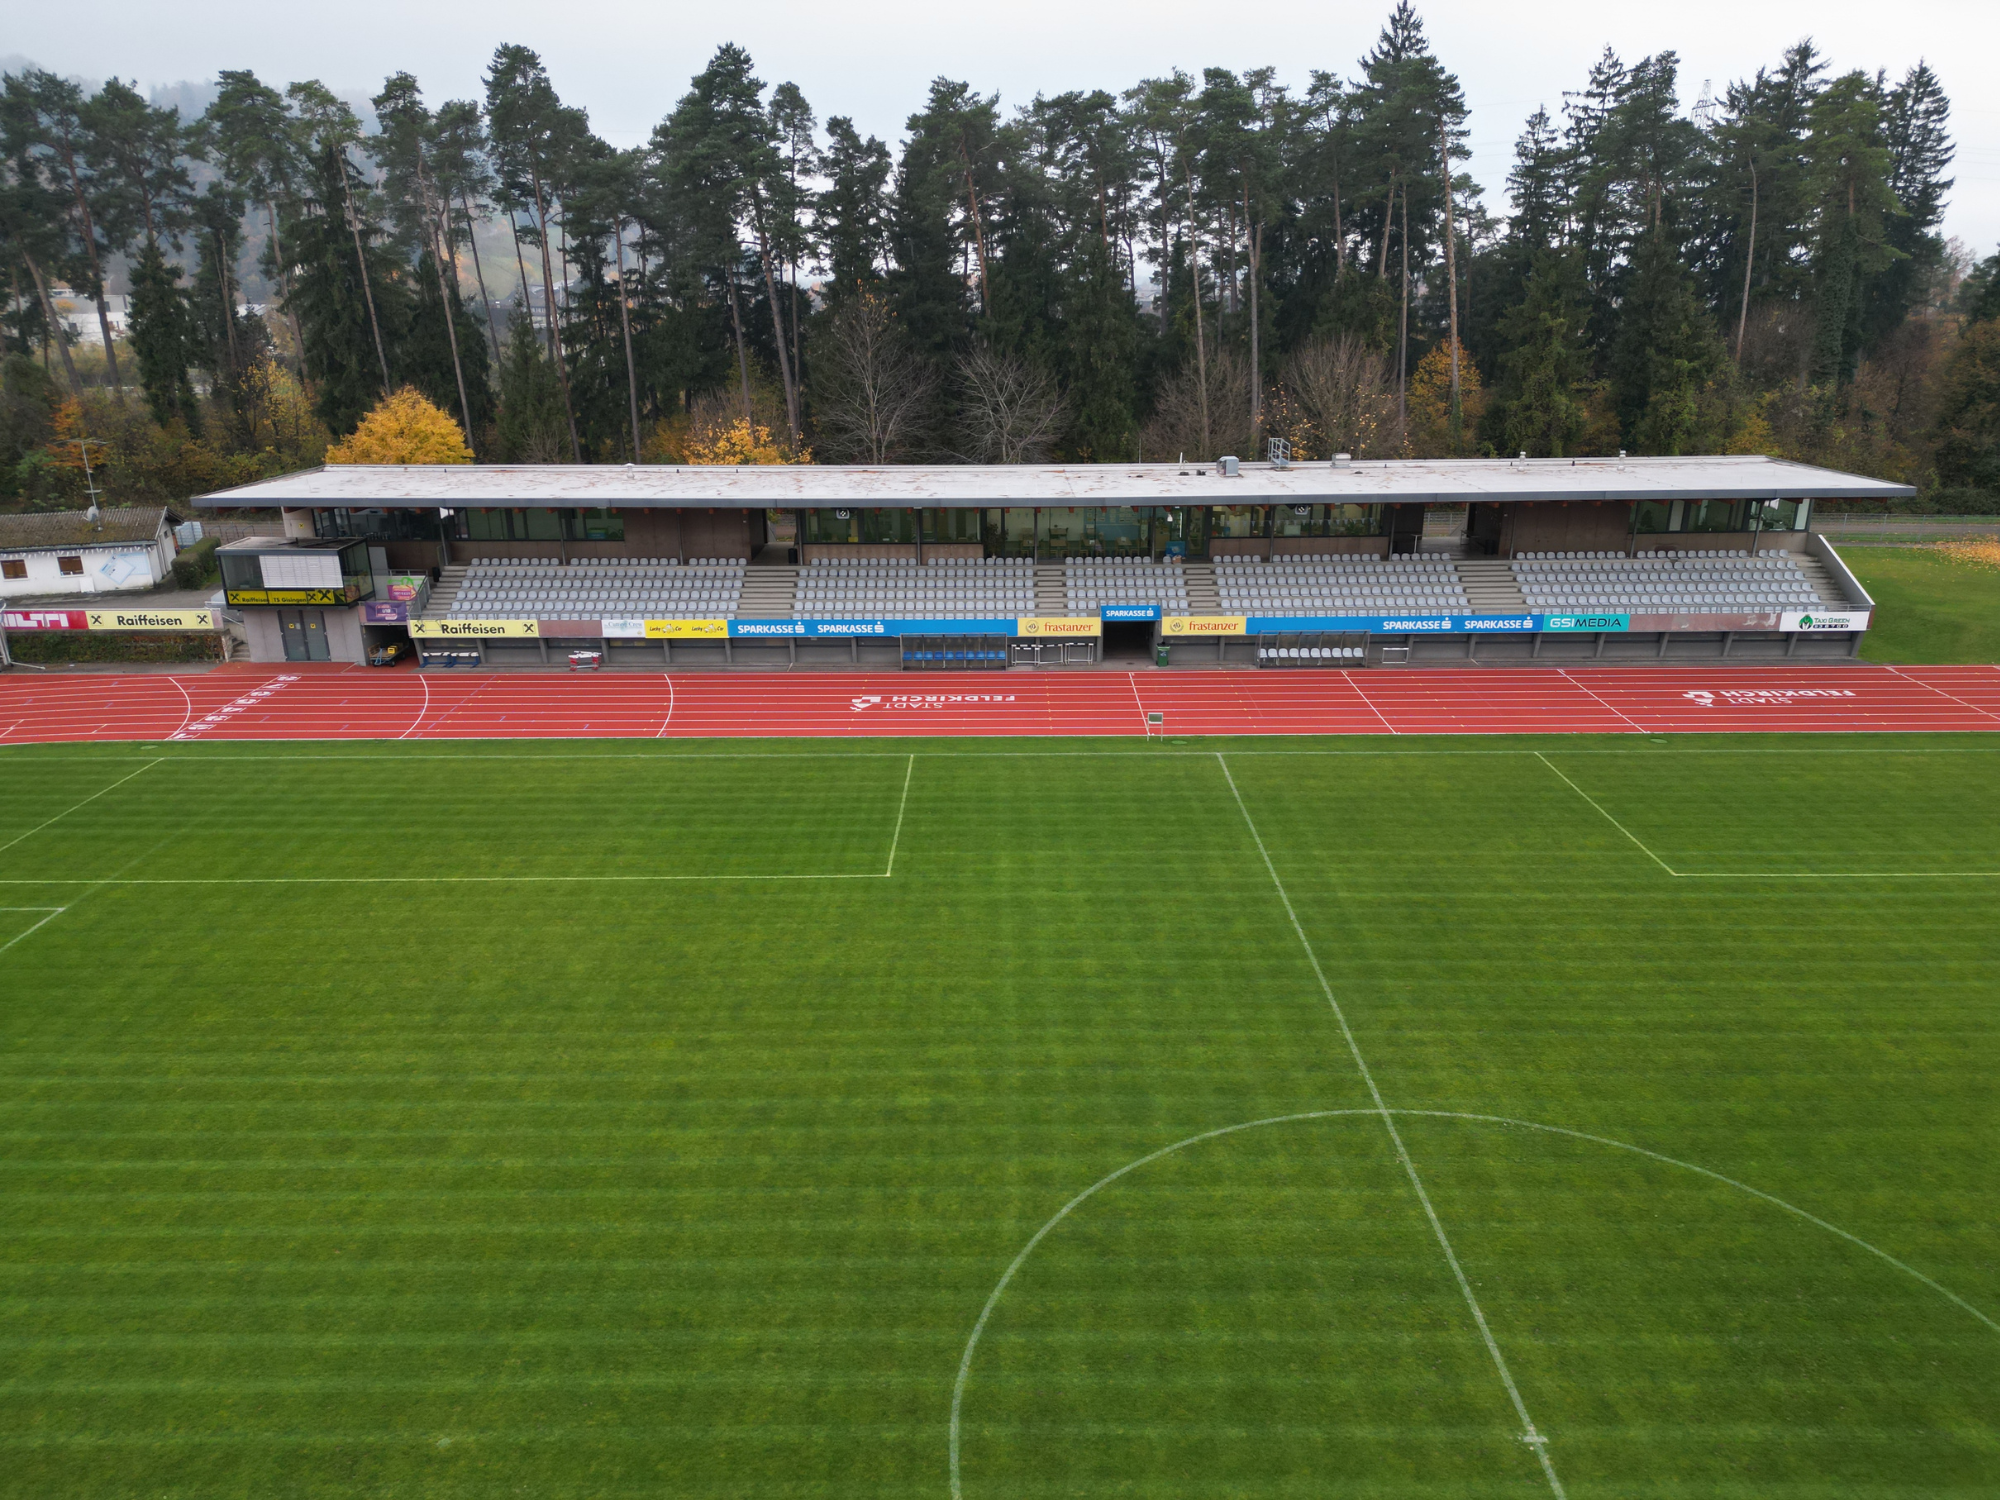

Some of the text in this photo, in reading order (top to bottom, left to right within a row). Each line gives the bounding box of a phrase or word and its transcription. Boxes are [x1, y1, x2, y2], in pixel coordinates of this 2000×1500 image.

[1105, 609, 1146, 617] SPARKASSE
[117, 615, 182, 626] Raiffeisen
[1189, 620, 1238, 631] frastanzer
[1383, 620, 1440, 630] SPARKASSE
[1464, 619, 1522, 629] SPARKASSE
[441, 623, 505, 634] Raiffeisen
[737, 624, 794, 634] SPARKASSE
[817, 624, 873, 633] SPARKASSE
[1044, 621, 1093, 632] frastanzer
